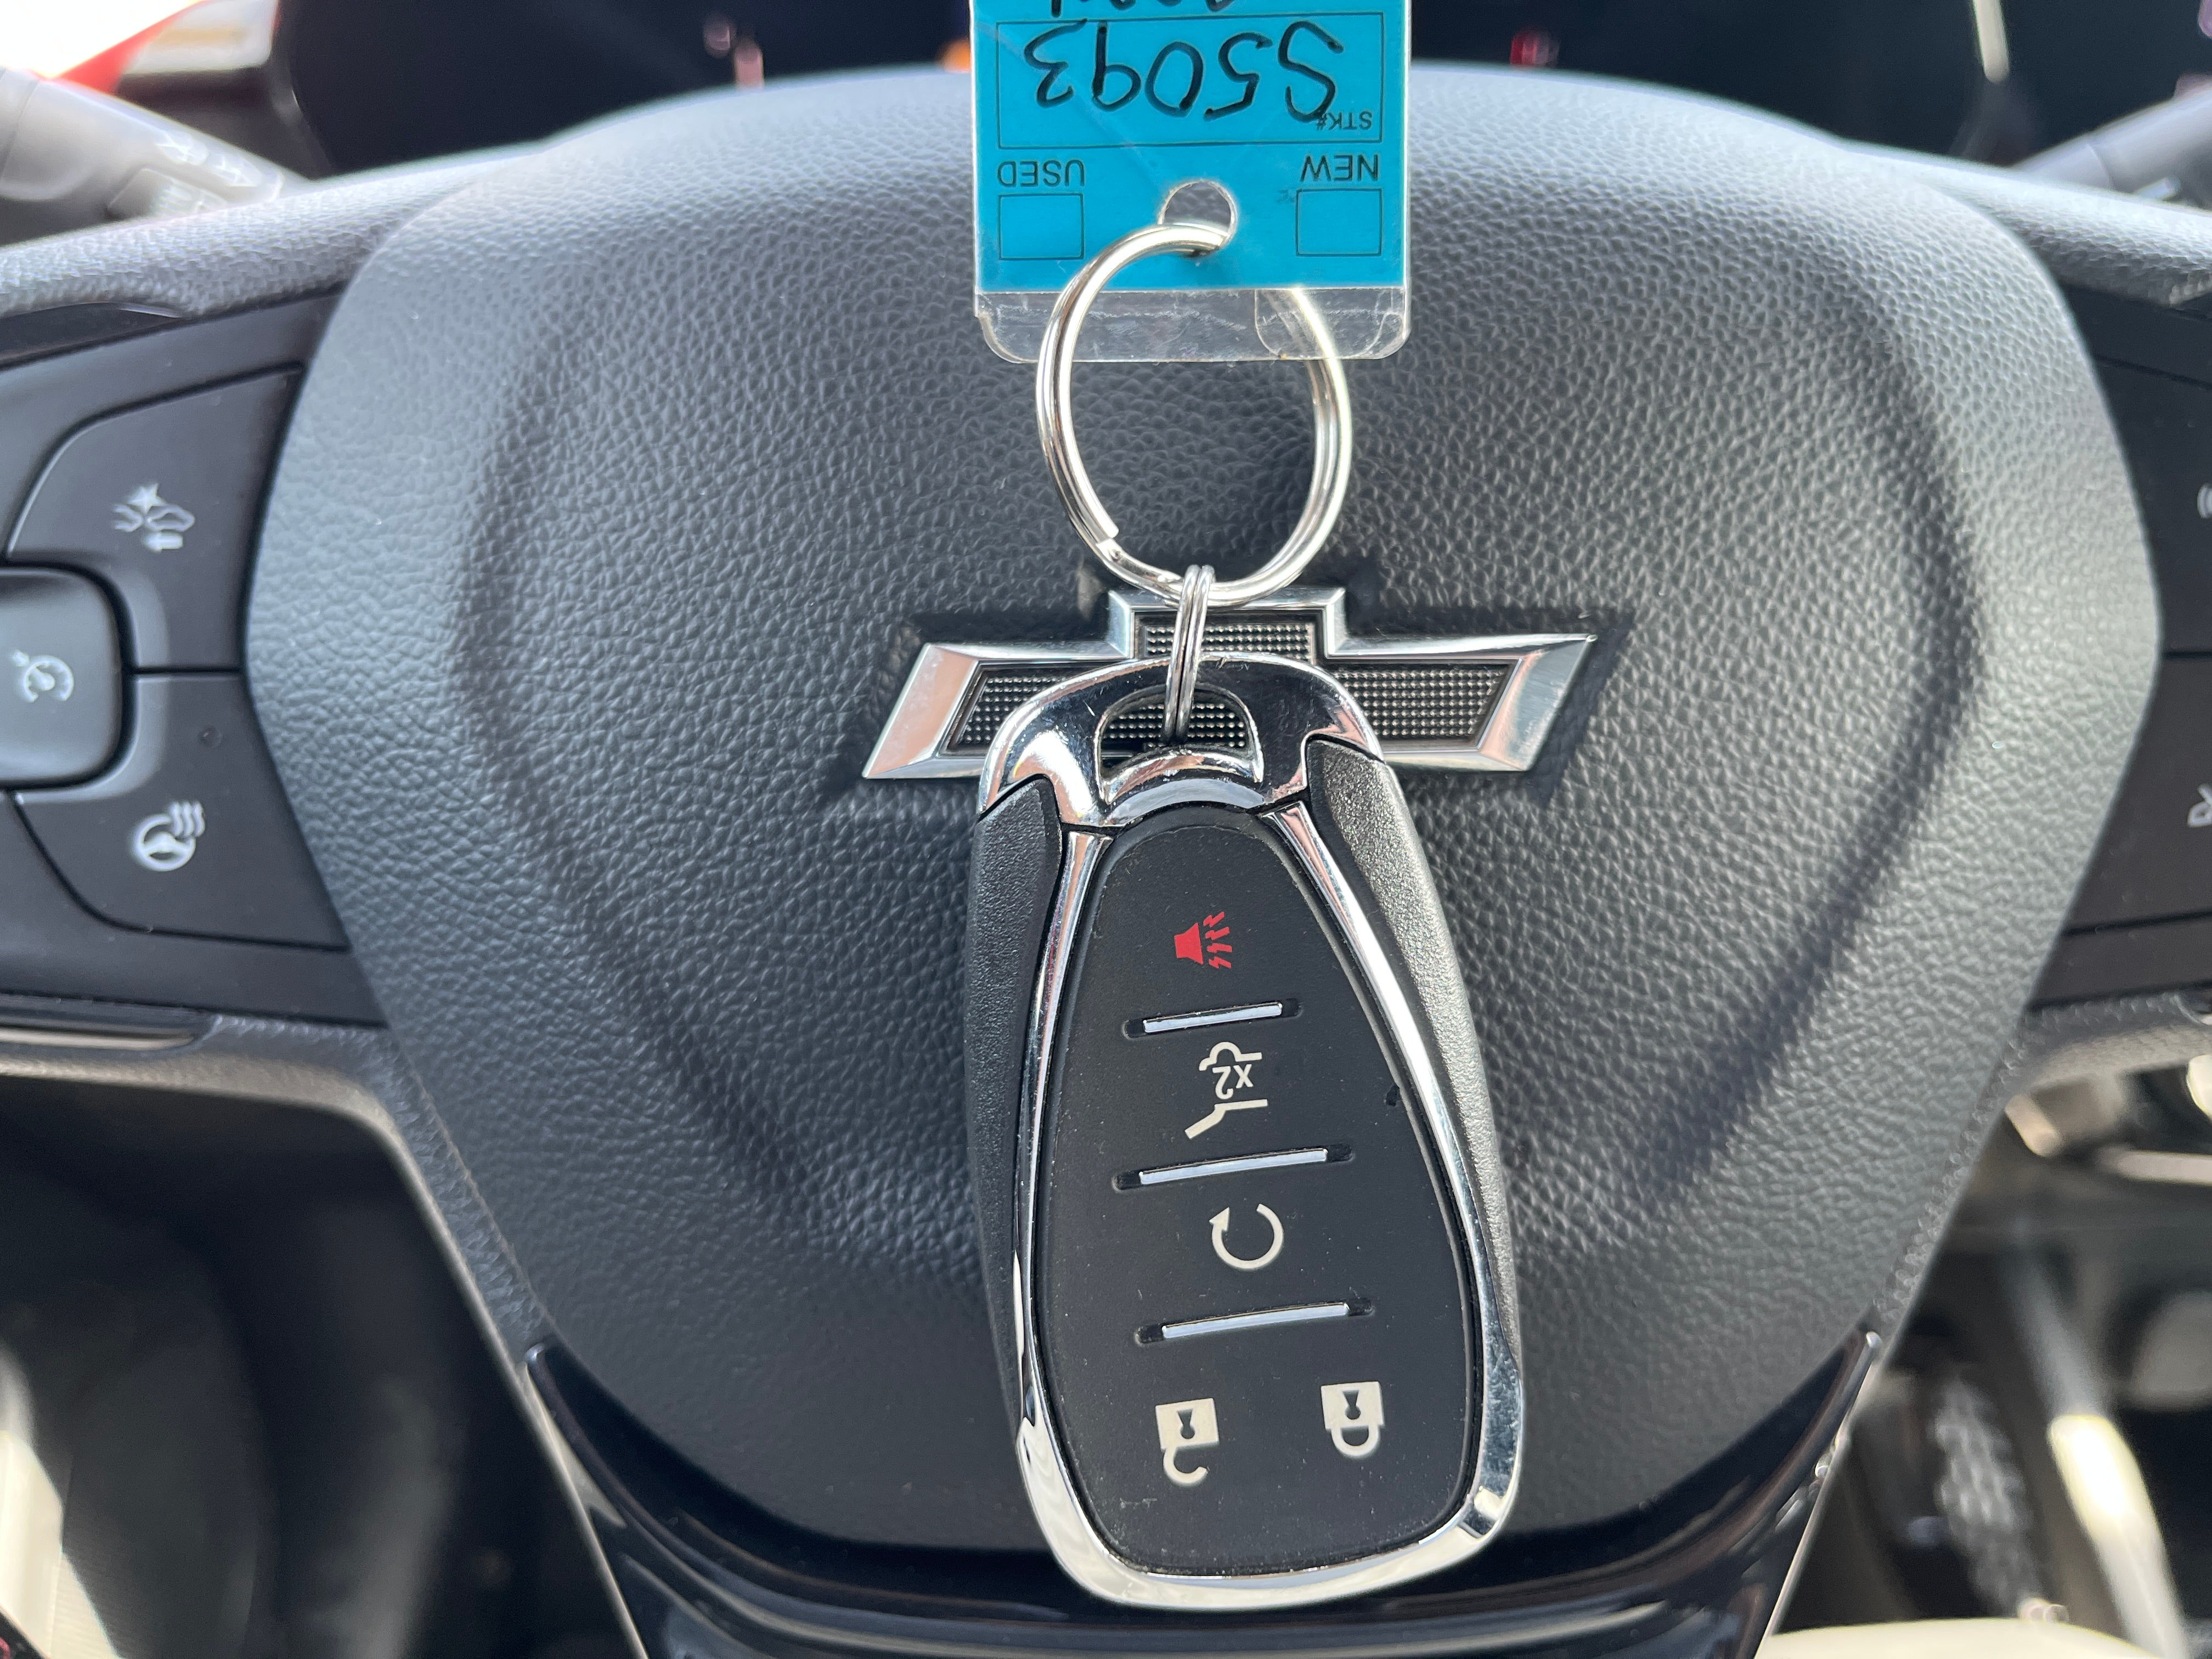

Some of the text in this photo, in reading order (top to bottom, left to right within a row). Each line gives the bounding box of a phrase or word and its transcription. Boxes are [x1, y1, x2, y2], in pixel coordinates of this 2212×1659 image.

[1024, 19, 1344, 122] S5093
[997, 159, 1085, 187] USED
[1300, 154, 1379, 182] NEW
